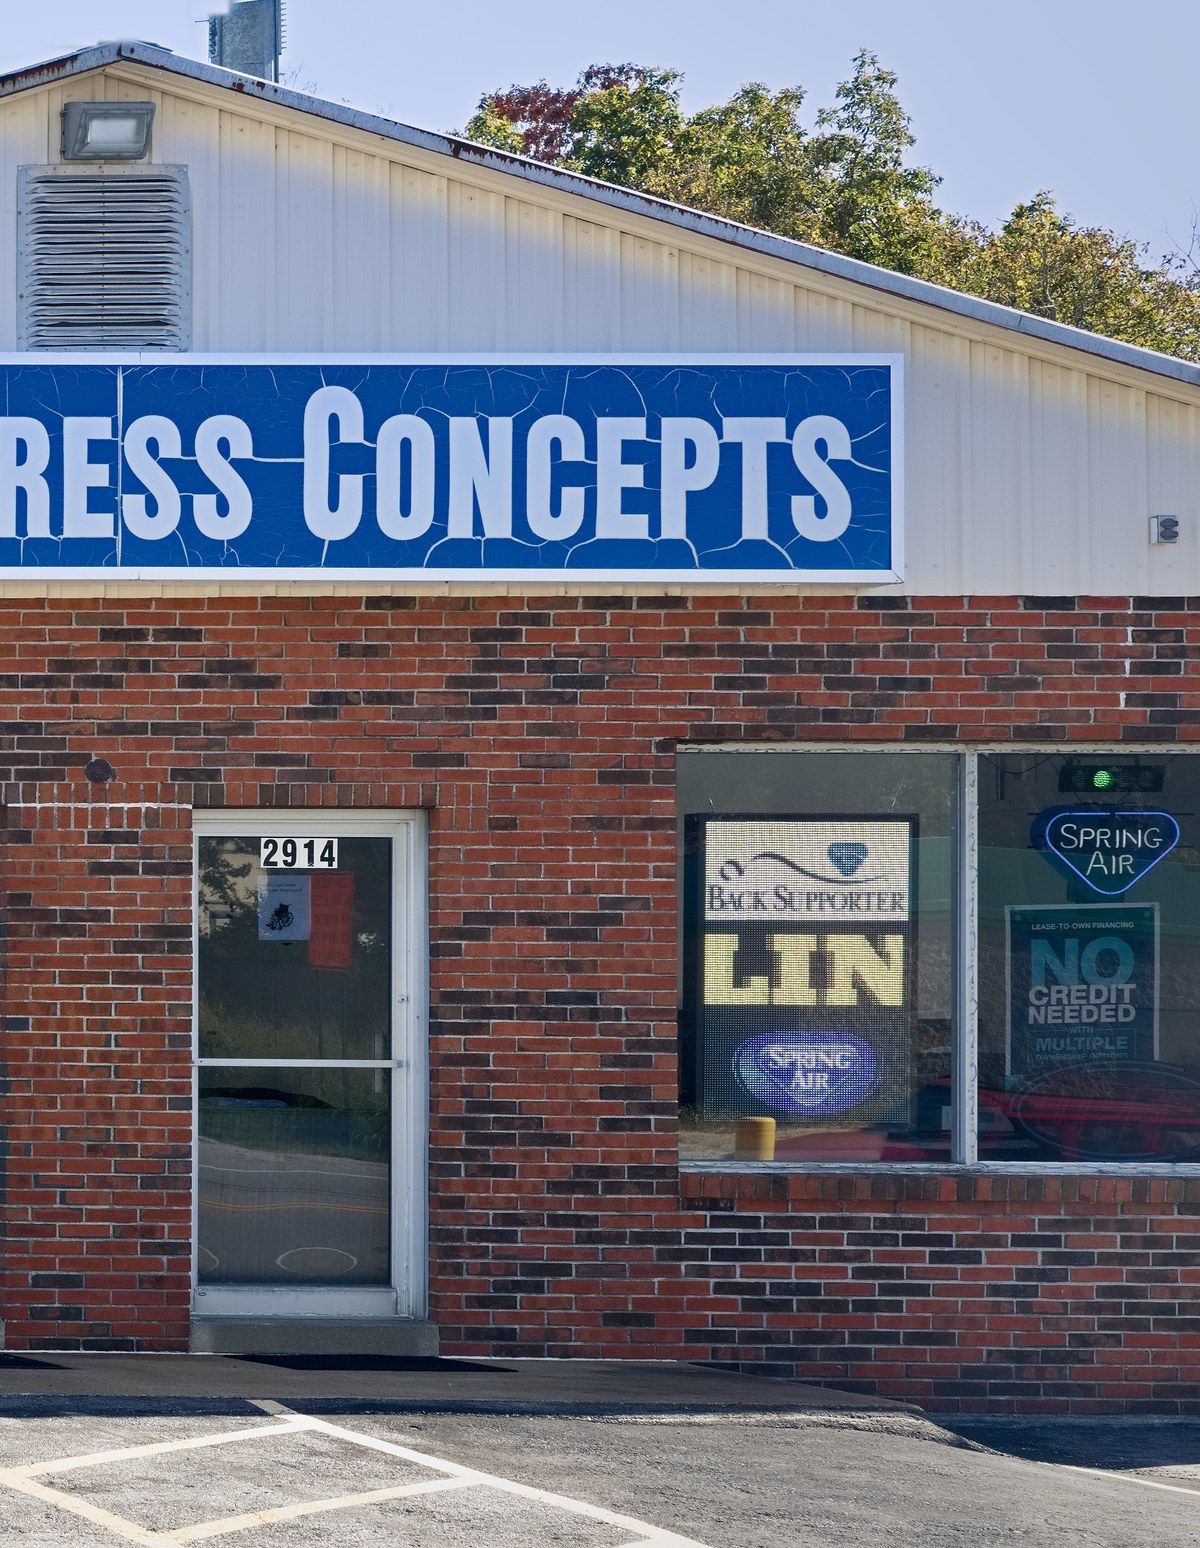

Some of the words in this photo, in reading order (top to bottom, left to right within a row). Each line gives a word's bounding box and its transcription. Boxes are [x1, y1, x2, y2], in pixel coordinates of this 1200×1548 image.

[303, 386, 851, 542] CONCEPTS
[1060, 822, 1164, 850] SPRING
[263, 839, 335, 867] 2914
[1085, 851, 1135, 876] AIR
[708, 884, 770, 912] BACK
[773, 884, 905, 912] SUPPORTER
[1031, 922, 1091, 931] LEASE-TO-OWN
[1092, 921, 1135, 930] FINANCING
[1030, 936, 1135, 987] NO
[1028, 983, 1137, 1006] CREDIT
[1028, 1003, 1137, 1025] NEEDED
[1069, 1026, 1094, 1034] WITH
[1035, 1036, 1129, 1052] MULTIPLE
[768, 1045, 852, 1070] SPRING
[791, 1069, 830, 1090] AIR
